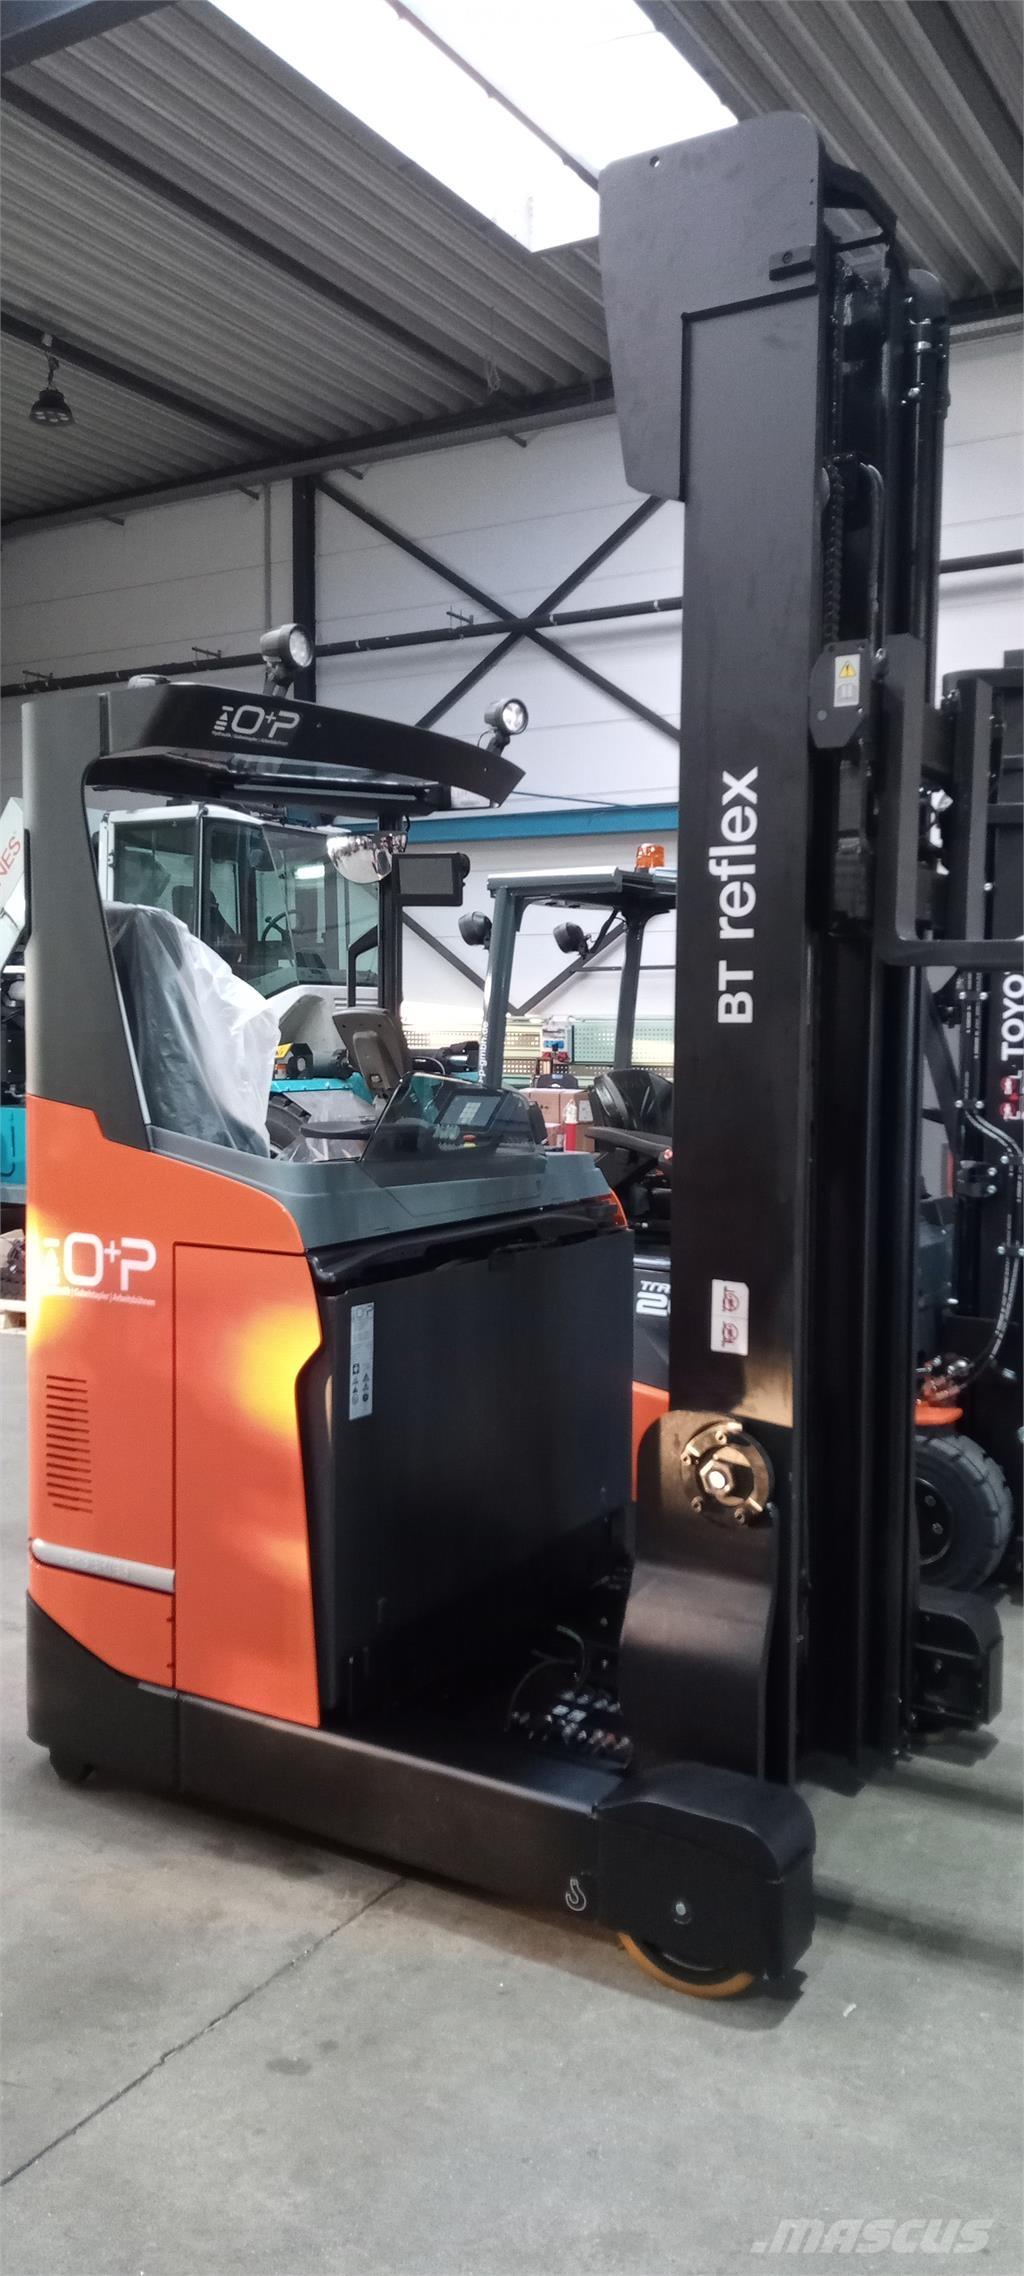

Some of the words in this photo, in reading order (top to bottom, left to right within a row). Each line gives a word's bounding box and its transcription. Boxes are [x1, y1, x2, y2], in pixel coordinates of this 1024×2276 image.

[708, 766, 759, 940] reflex
[717, 959, 754, 1024] BT
[1001, 971, 1024, 1062] TOYO
[636, 1291, 671, 1317] 2
